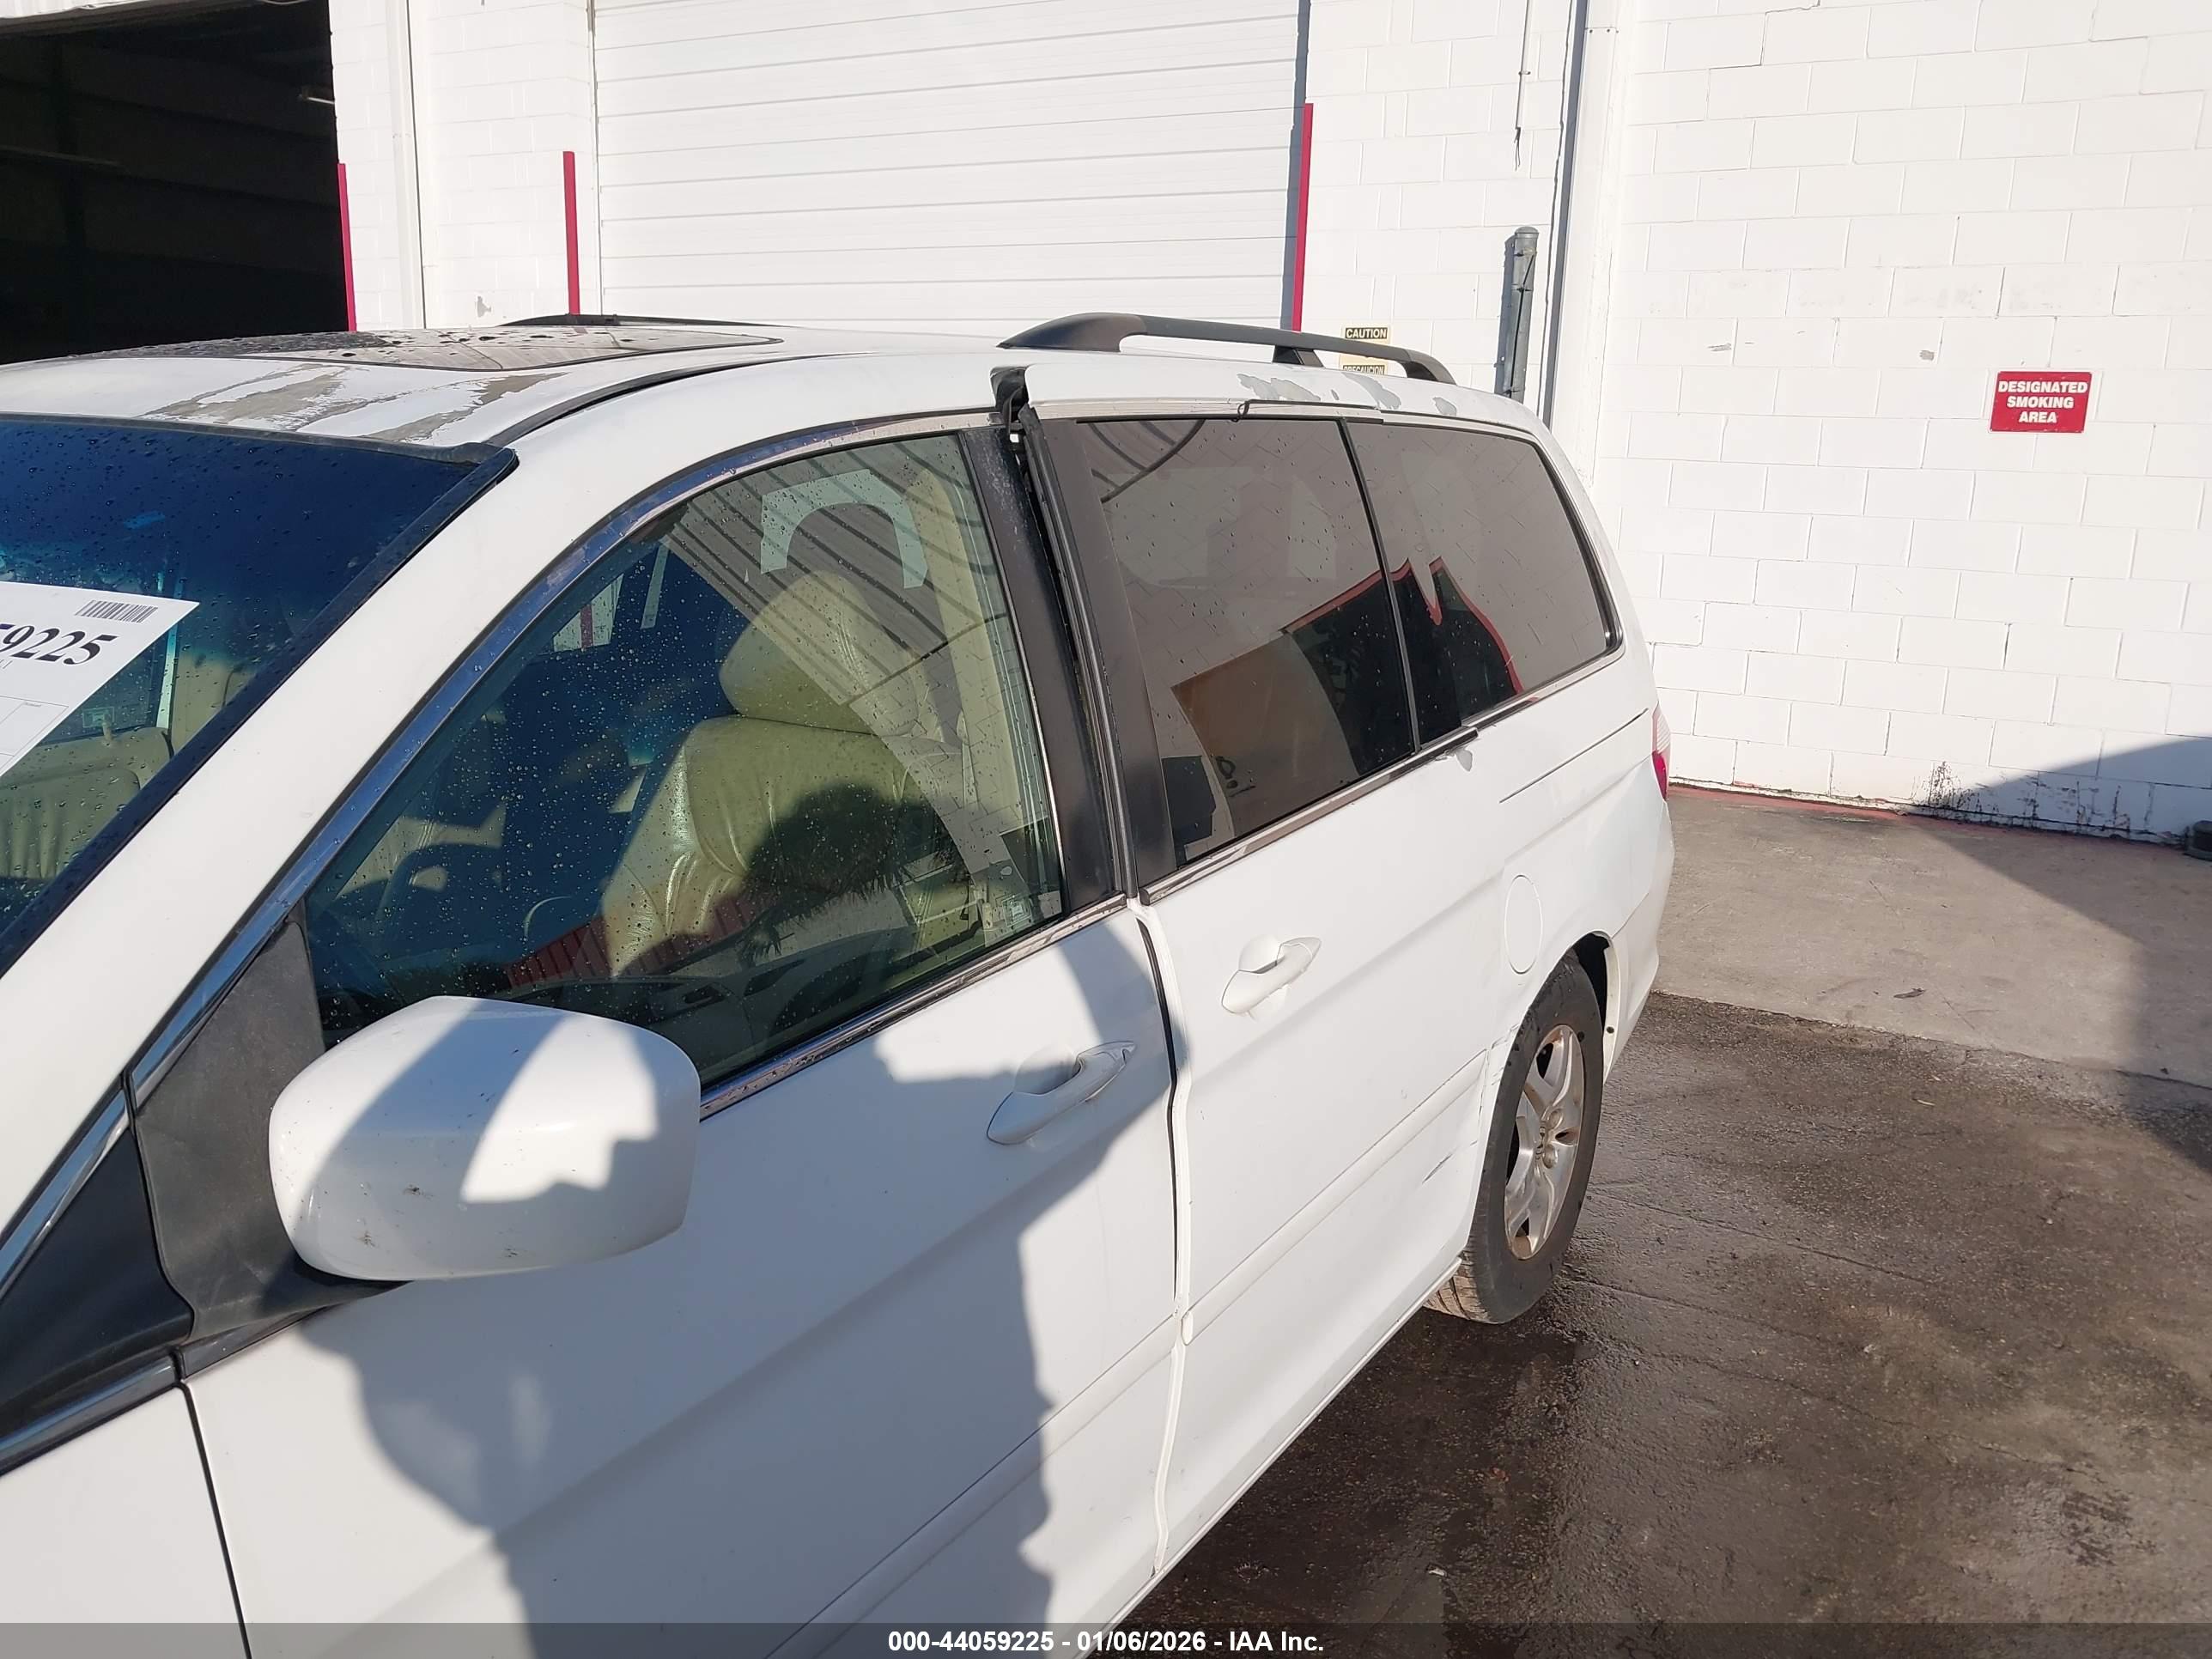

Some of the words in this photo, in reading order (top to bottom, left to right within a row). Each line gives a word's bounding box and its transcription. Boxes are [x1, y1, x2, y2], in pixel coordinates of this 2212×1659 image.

[1346, 328, 1387, 338] CAUTION
[1998, 380, 2088, 393] DESIGNATED
[2006, 396, 2075, 409] SMOKING
[2018, 411, 2057, 423] AREA
